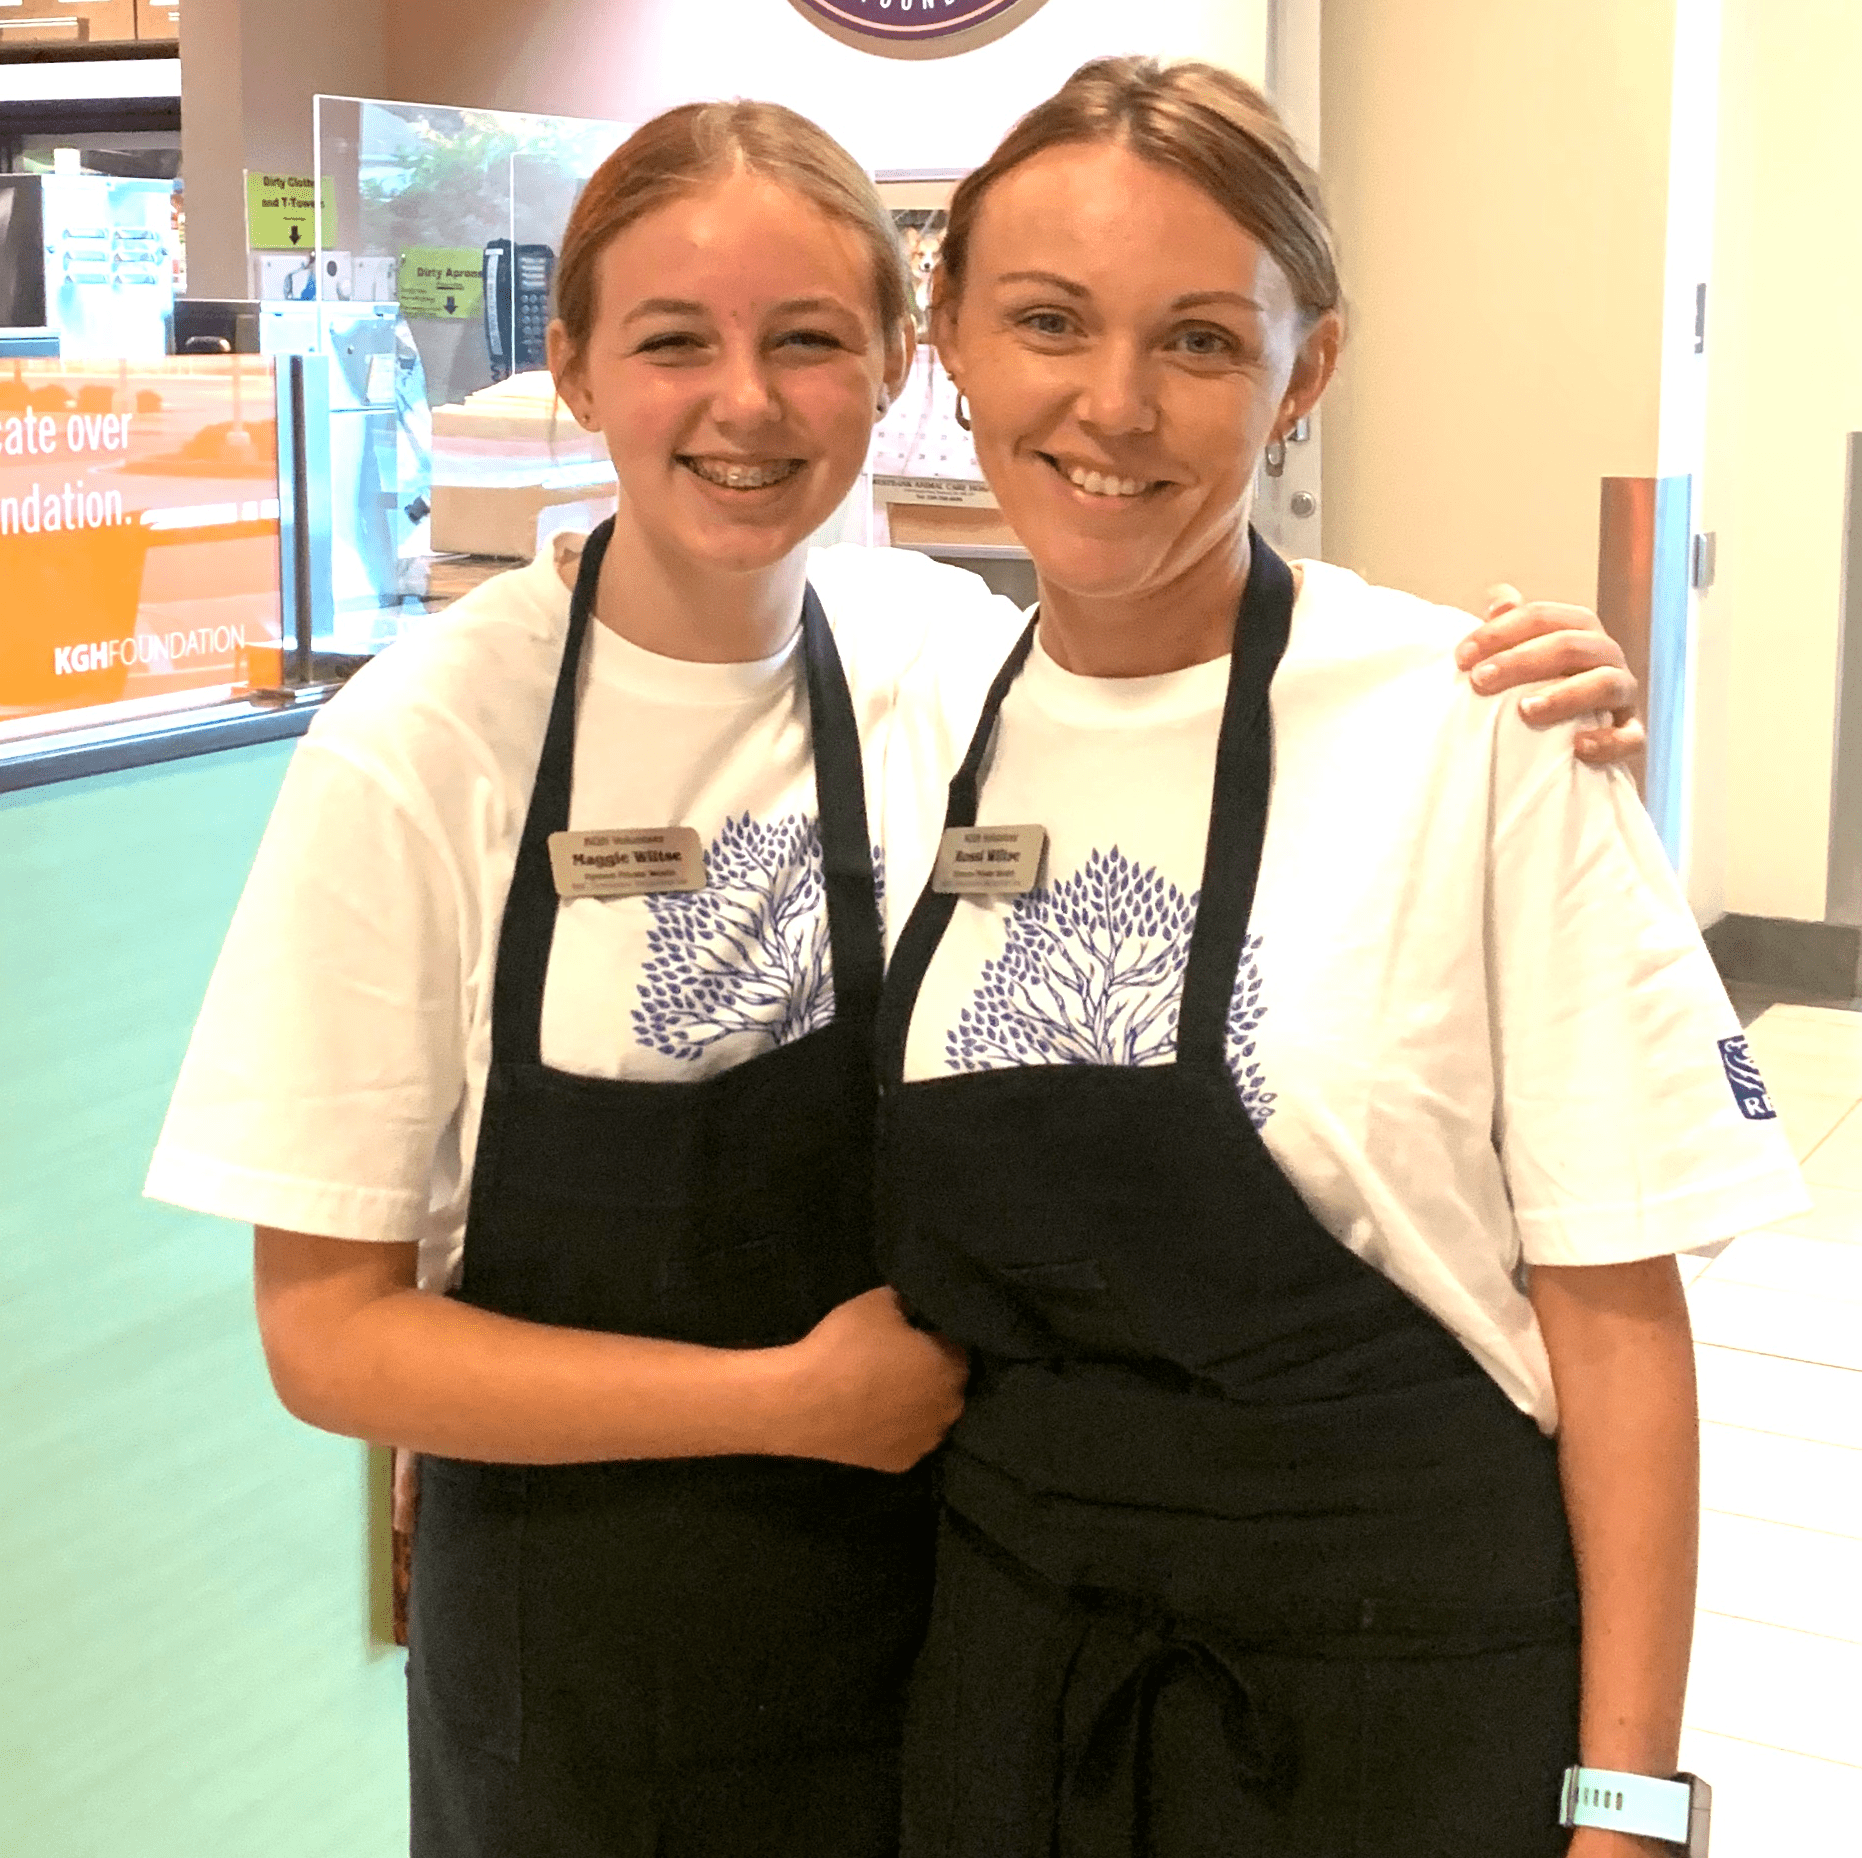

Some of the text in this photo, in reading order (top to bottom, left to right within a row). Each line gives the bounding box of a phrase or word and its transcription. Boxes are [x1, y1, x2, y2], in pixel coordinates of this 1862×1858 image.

[263, 176, 285, 189] Dirty
[262, 197, 279, 208] and
[417, 267, 442, 280] Dirty
[0, 405, 133, 455] ate over
[572, 851, 630, 869] Maggie
